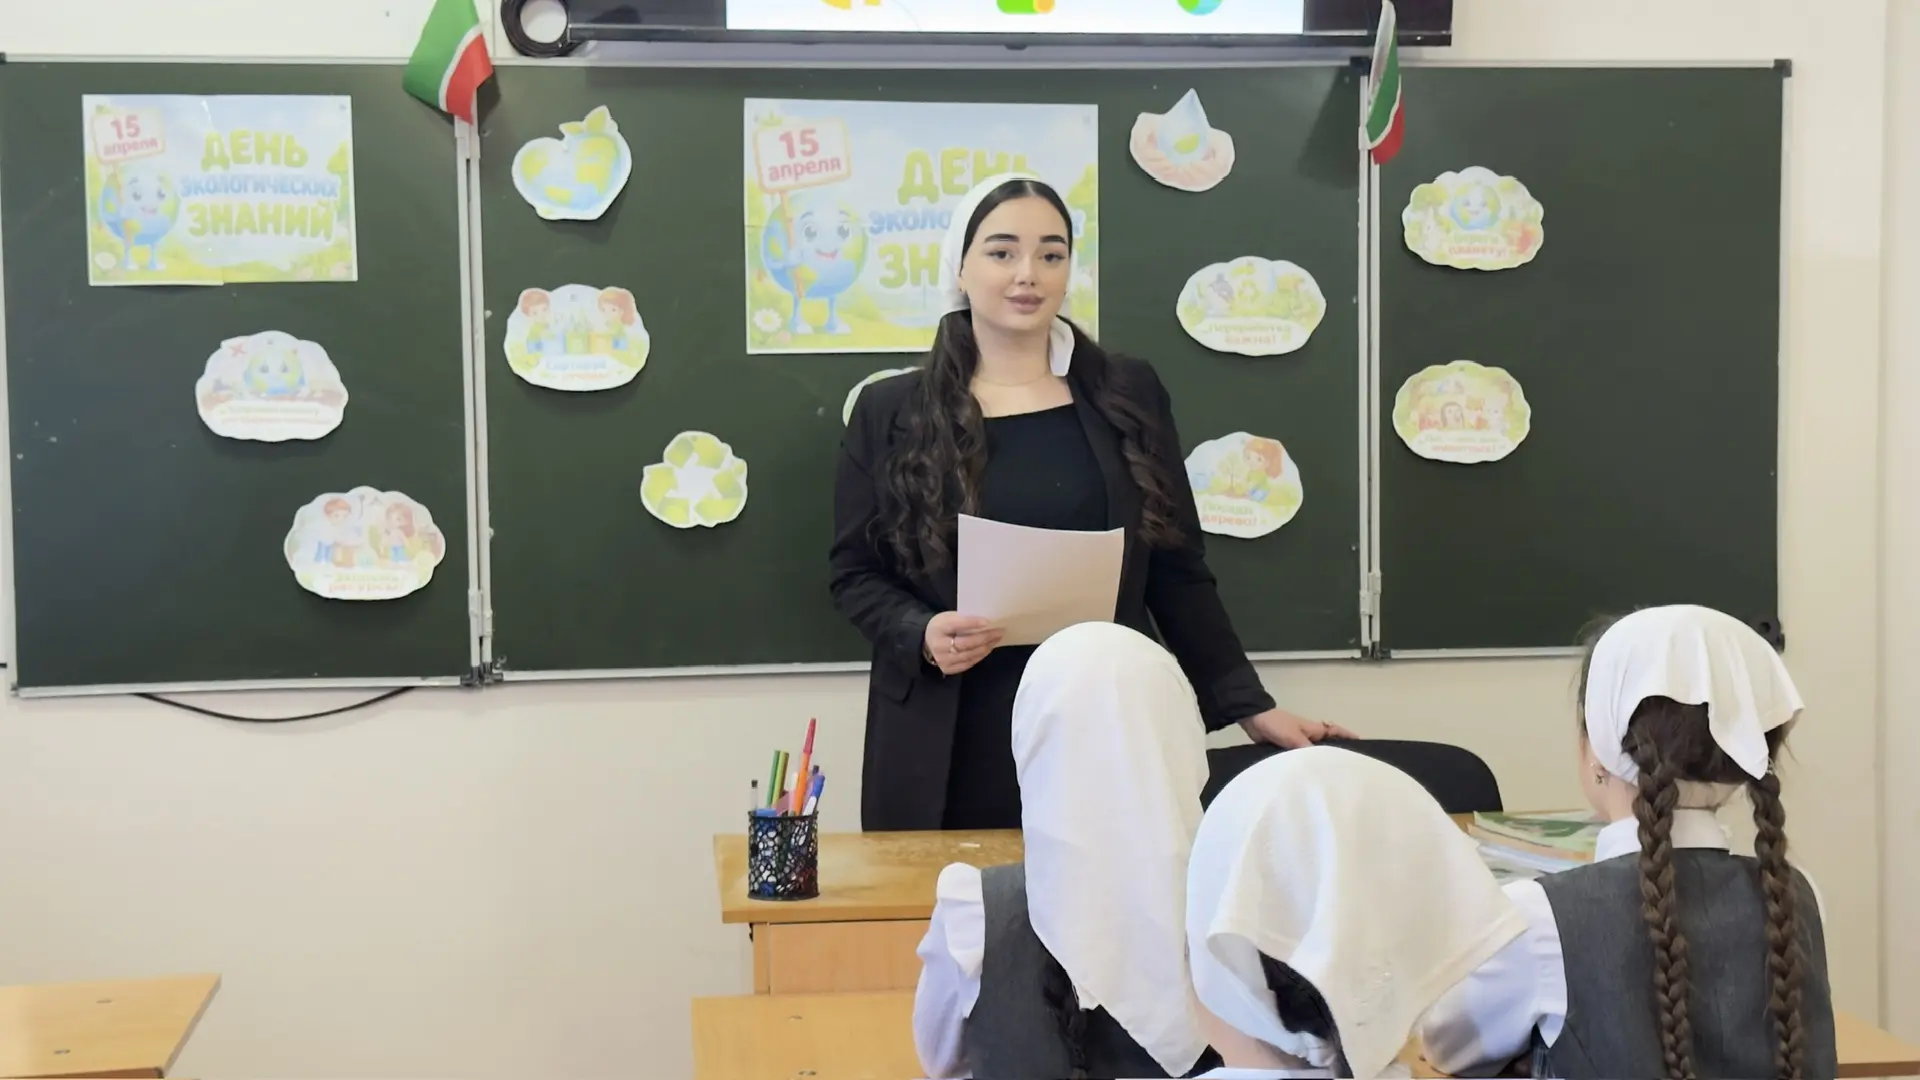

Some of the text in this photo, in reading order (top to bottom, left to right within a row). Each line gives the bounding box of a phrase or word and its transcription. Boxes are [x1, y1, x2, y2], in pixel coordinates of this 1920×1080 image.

[111, 115, 141, 140] 15
[103, 137, 158, 157] апреля
[200, 129, 309, 172] ДЕНЬ
[779, 128, 820, 160] 15
[768, 157, 842, 182] апреля
[181, 174, 339, 198] ЭКОЛОГИЧЕСКИХ
[187, 199, 336, 242] ЗНАНИЙ
